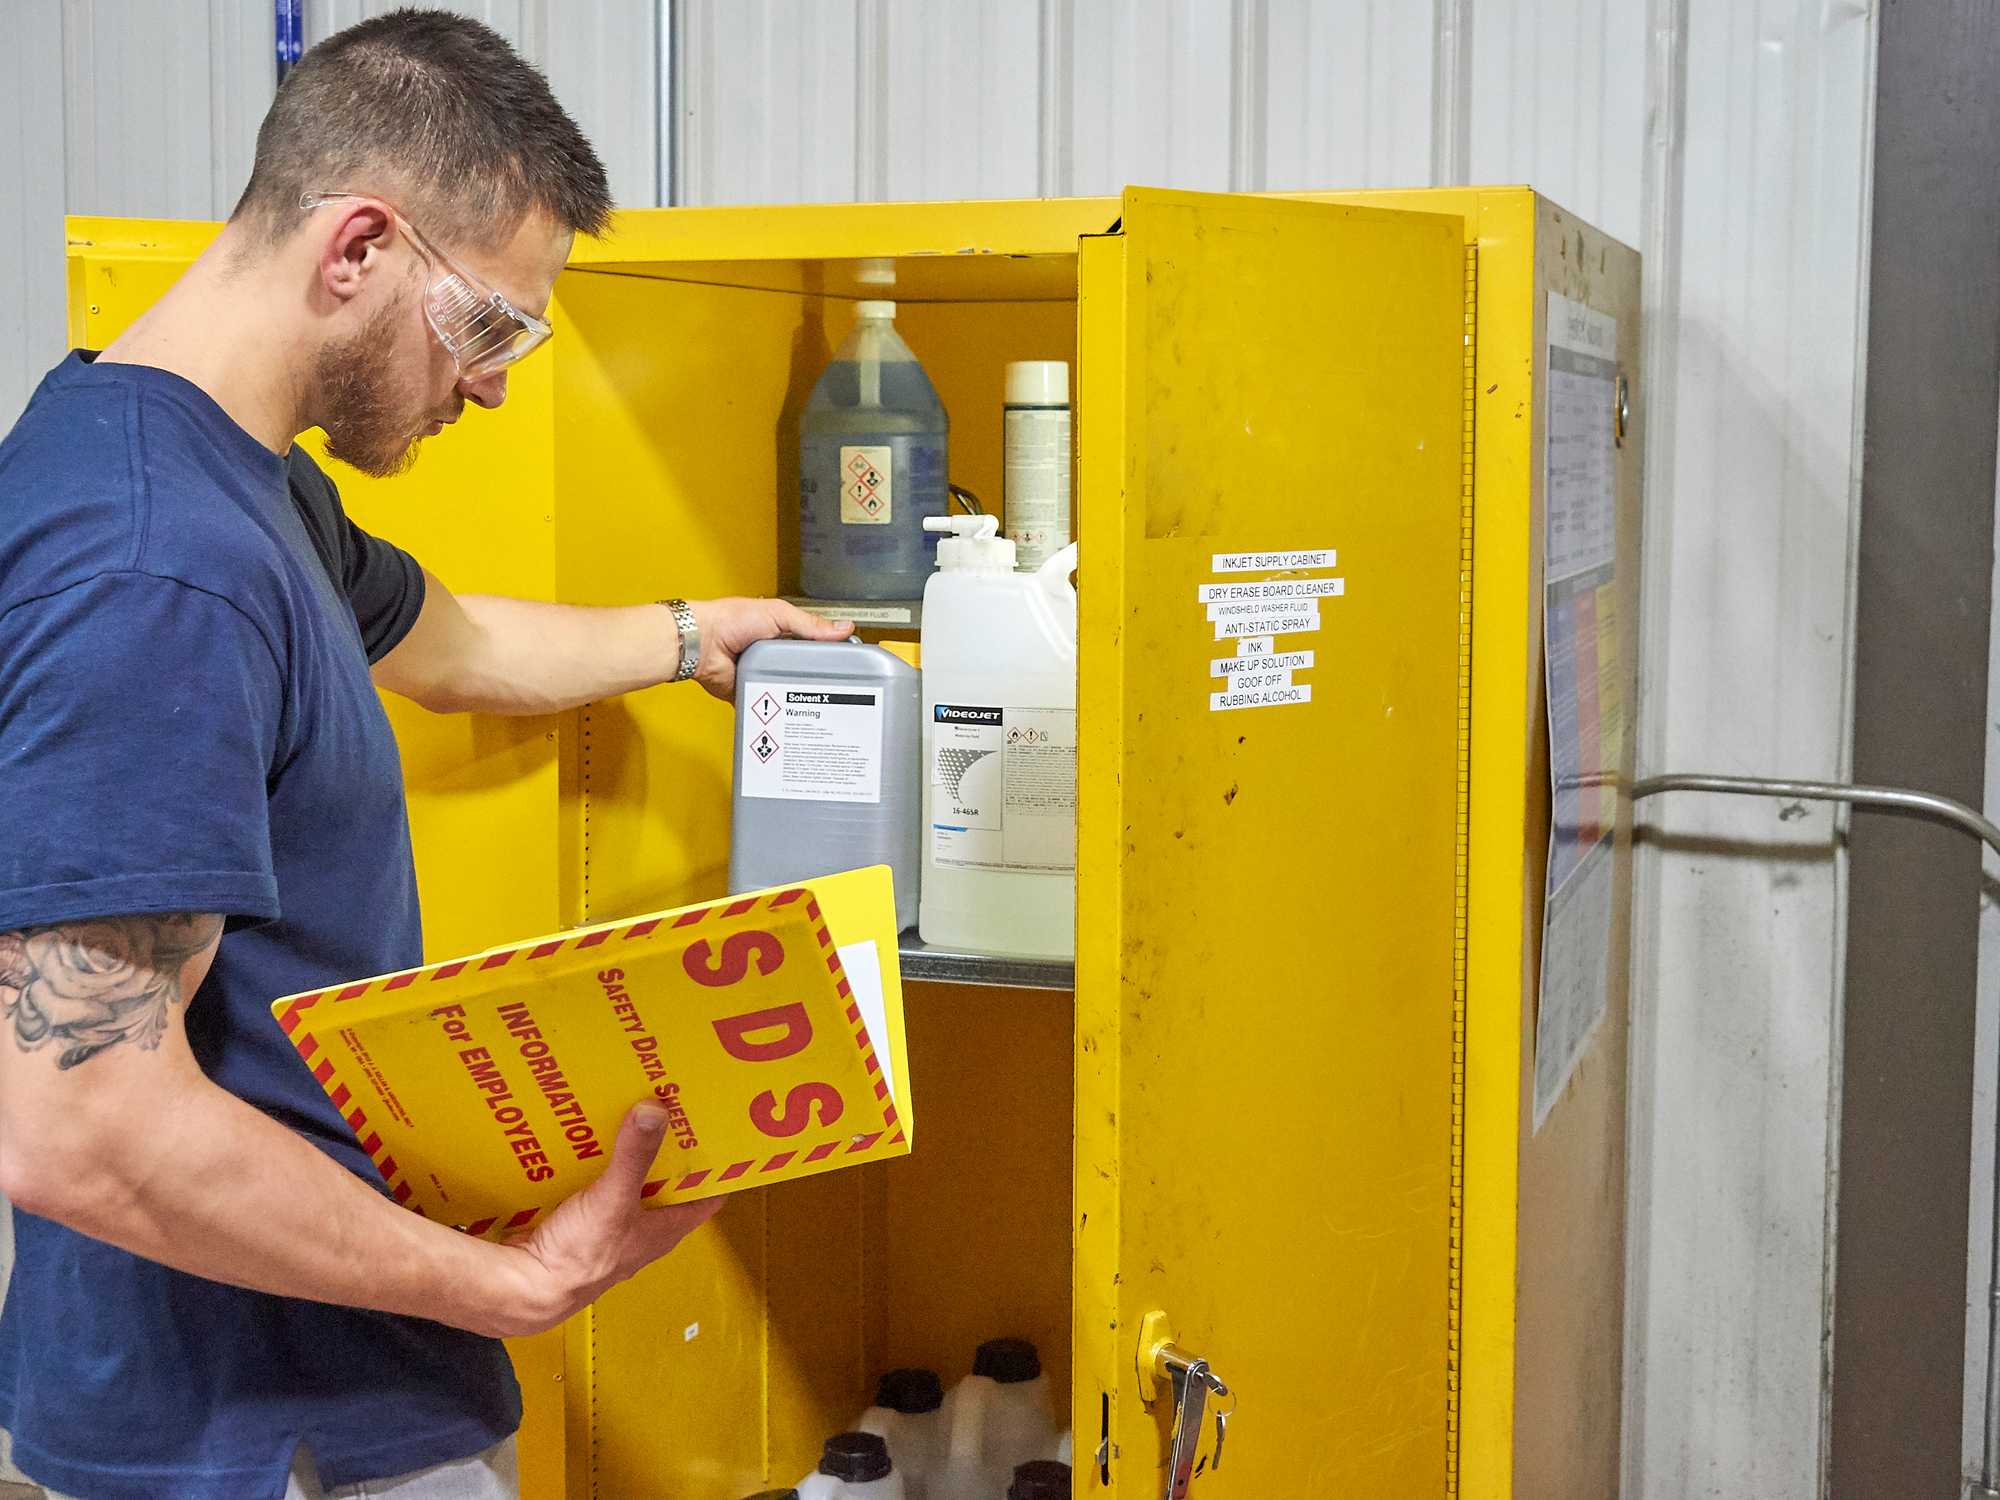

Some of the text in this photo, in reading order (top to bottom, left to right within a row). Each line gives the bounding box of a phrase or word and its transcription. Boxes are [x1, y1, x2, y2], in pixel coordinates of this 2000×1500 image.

[1222, 553, 1327, 569] INKJET SUPPLY CABINET
[1208, 583, 1335, 600] DRY ERASE BOARD CLEANER
[1218, 602, 1309, 616] WINDSHIELD WASHER FLUID
[1224, 617, 1311, 634] ANTI-STATIC SPRAY
[1248, 642, 1263, 653] INK
[1220, 655, 1305, 673] MAKE UP SOLUTION
[1237, 674, 1282, 689] GOOF OFF
[788, 693, 830, 703] Solvent X
[1220, 690, 1302, 706] RUBBING ALCOHOL
[785, 708, 821, 719] Warning
[941, 709, 1001, 720] VIDEOJET
[597, 967, 698, 1150] SAFETY DATA SHEETS
[496, 1001, 604, 1160] INFORMATION
[430, 1003, 554, 1183] For EMPLOYEES
